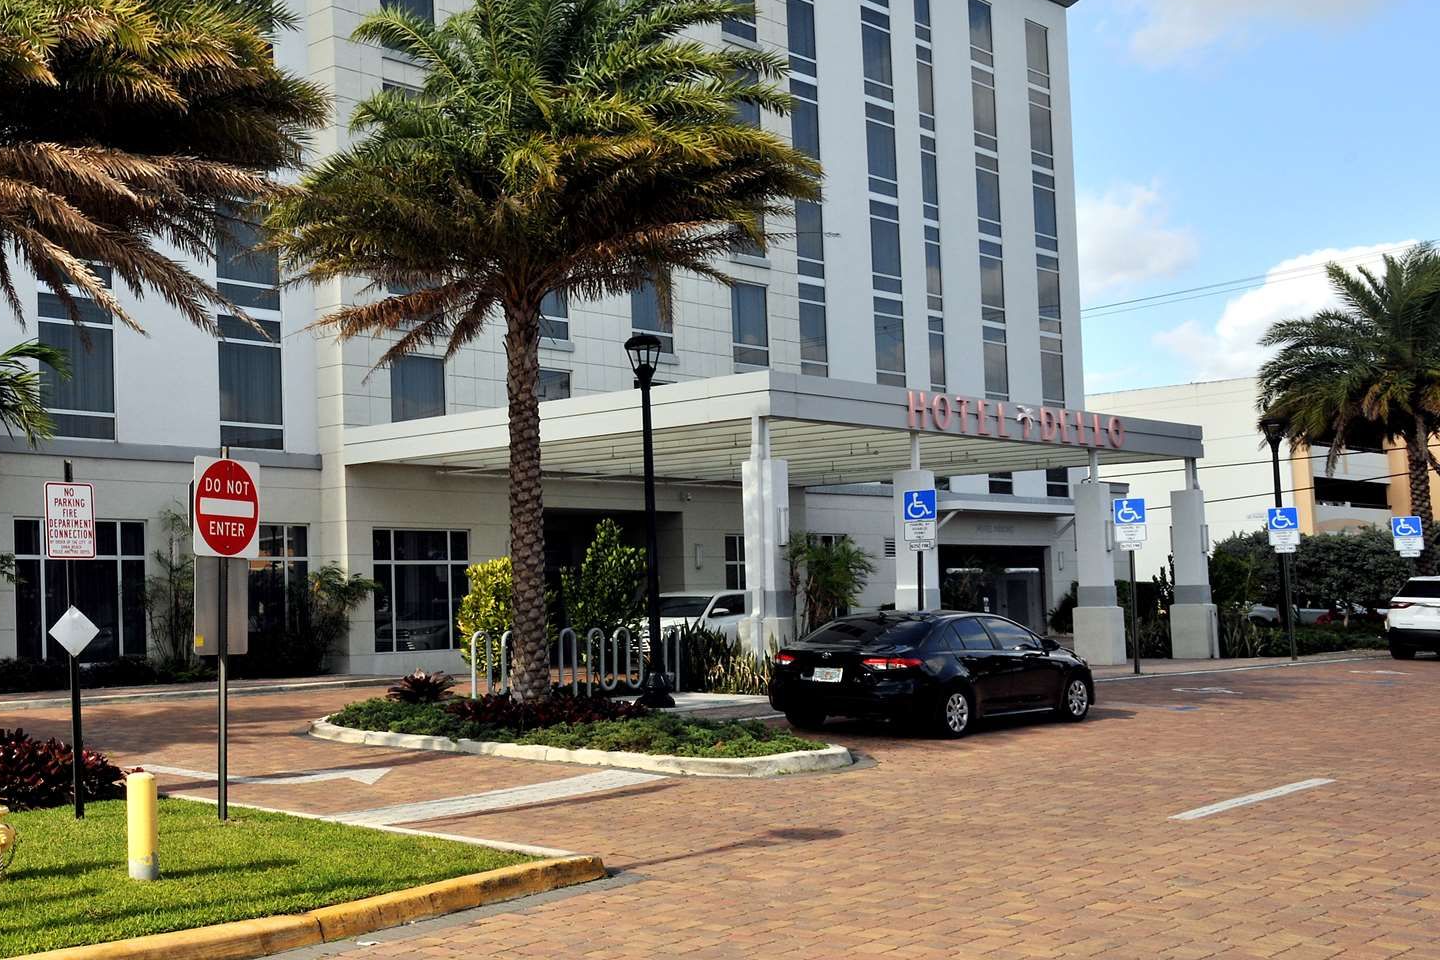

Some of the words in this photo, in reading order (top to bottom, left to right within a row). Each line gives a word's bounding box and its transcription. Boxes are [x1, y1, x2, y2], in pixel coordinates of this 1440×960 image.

[907, 390, 1010, 438] HOTEL
[1039, 406, 1126, 449] DELLO
[205, 476, 222, 493] DO
[226, 478, 250, 496] NOT
[64, 488, 75, 497] NO
[54, 498, 86, 508] PARKING
[63, 508, 78, 518] FIRE
[49, 518, 92, 529] DEPARTMENT
[49, 529, 93, 539] CONNECTION
[208, 520, 246, 538] ENTER
